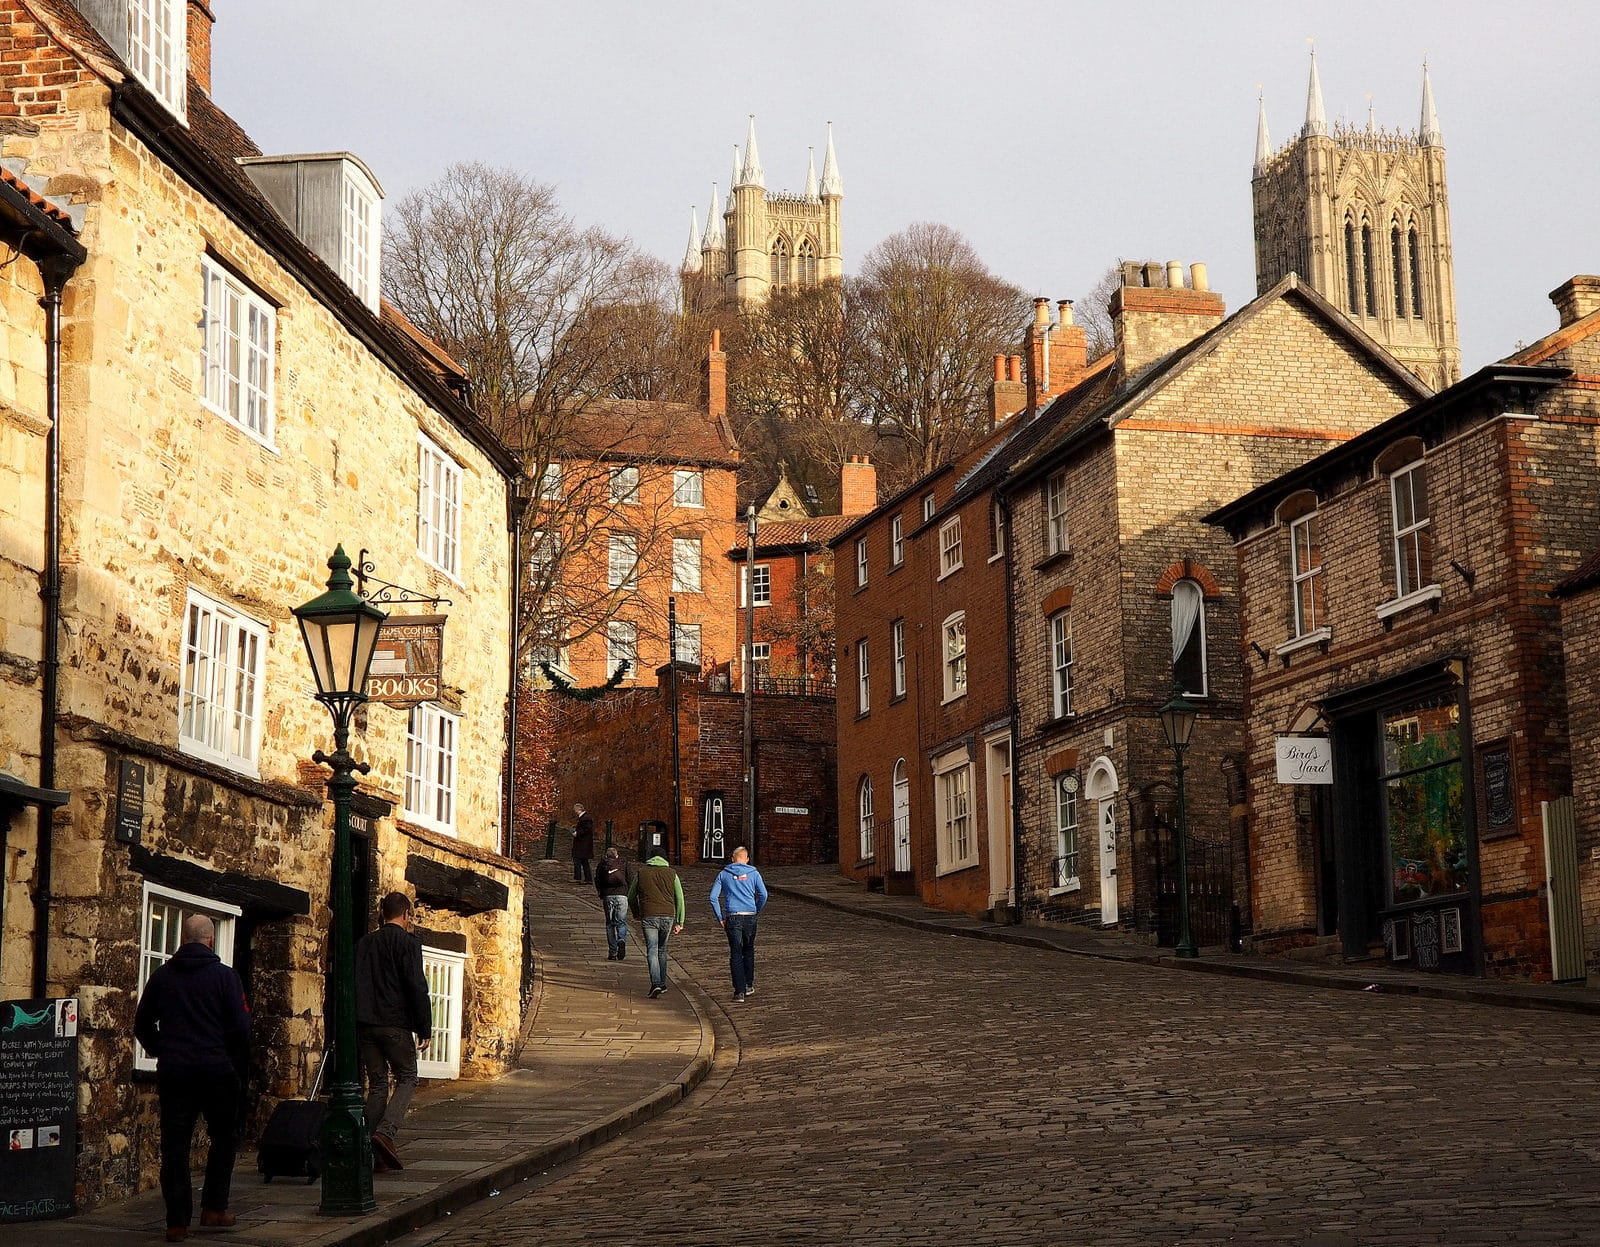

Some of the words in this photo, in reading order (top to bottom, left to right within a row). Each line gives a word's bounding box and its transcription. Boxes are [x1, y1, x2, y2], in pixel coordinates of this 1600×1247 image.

[379, 627, 402, 636] EWS'
[403, 626, 439, 635] COURT
[368, 678, 438, 697] BOOKS
[1280, 745, 1319, 760] Bird's
[1290, 759, 1330, 780] Yard
